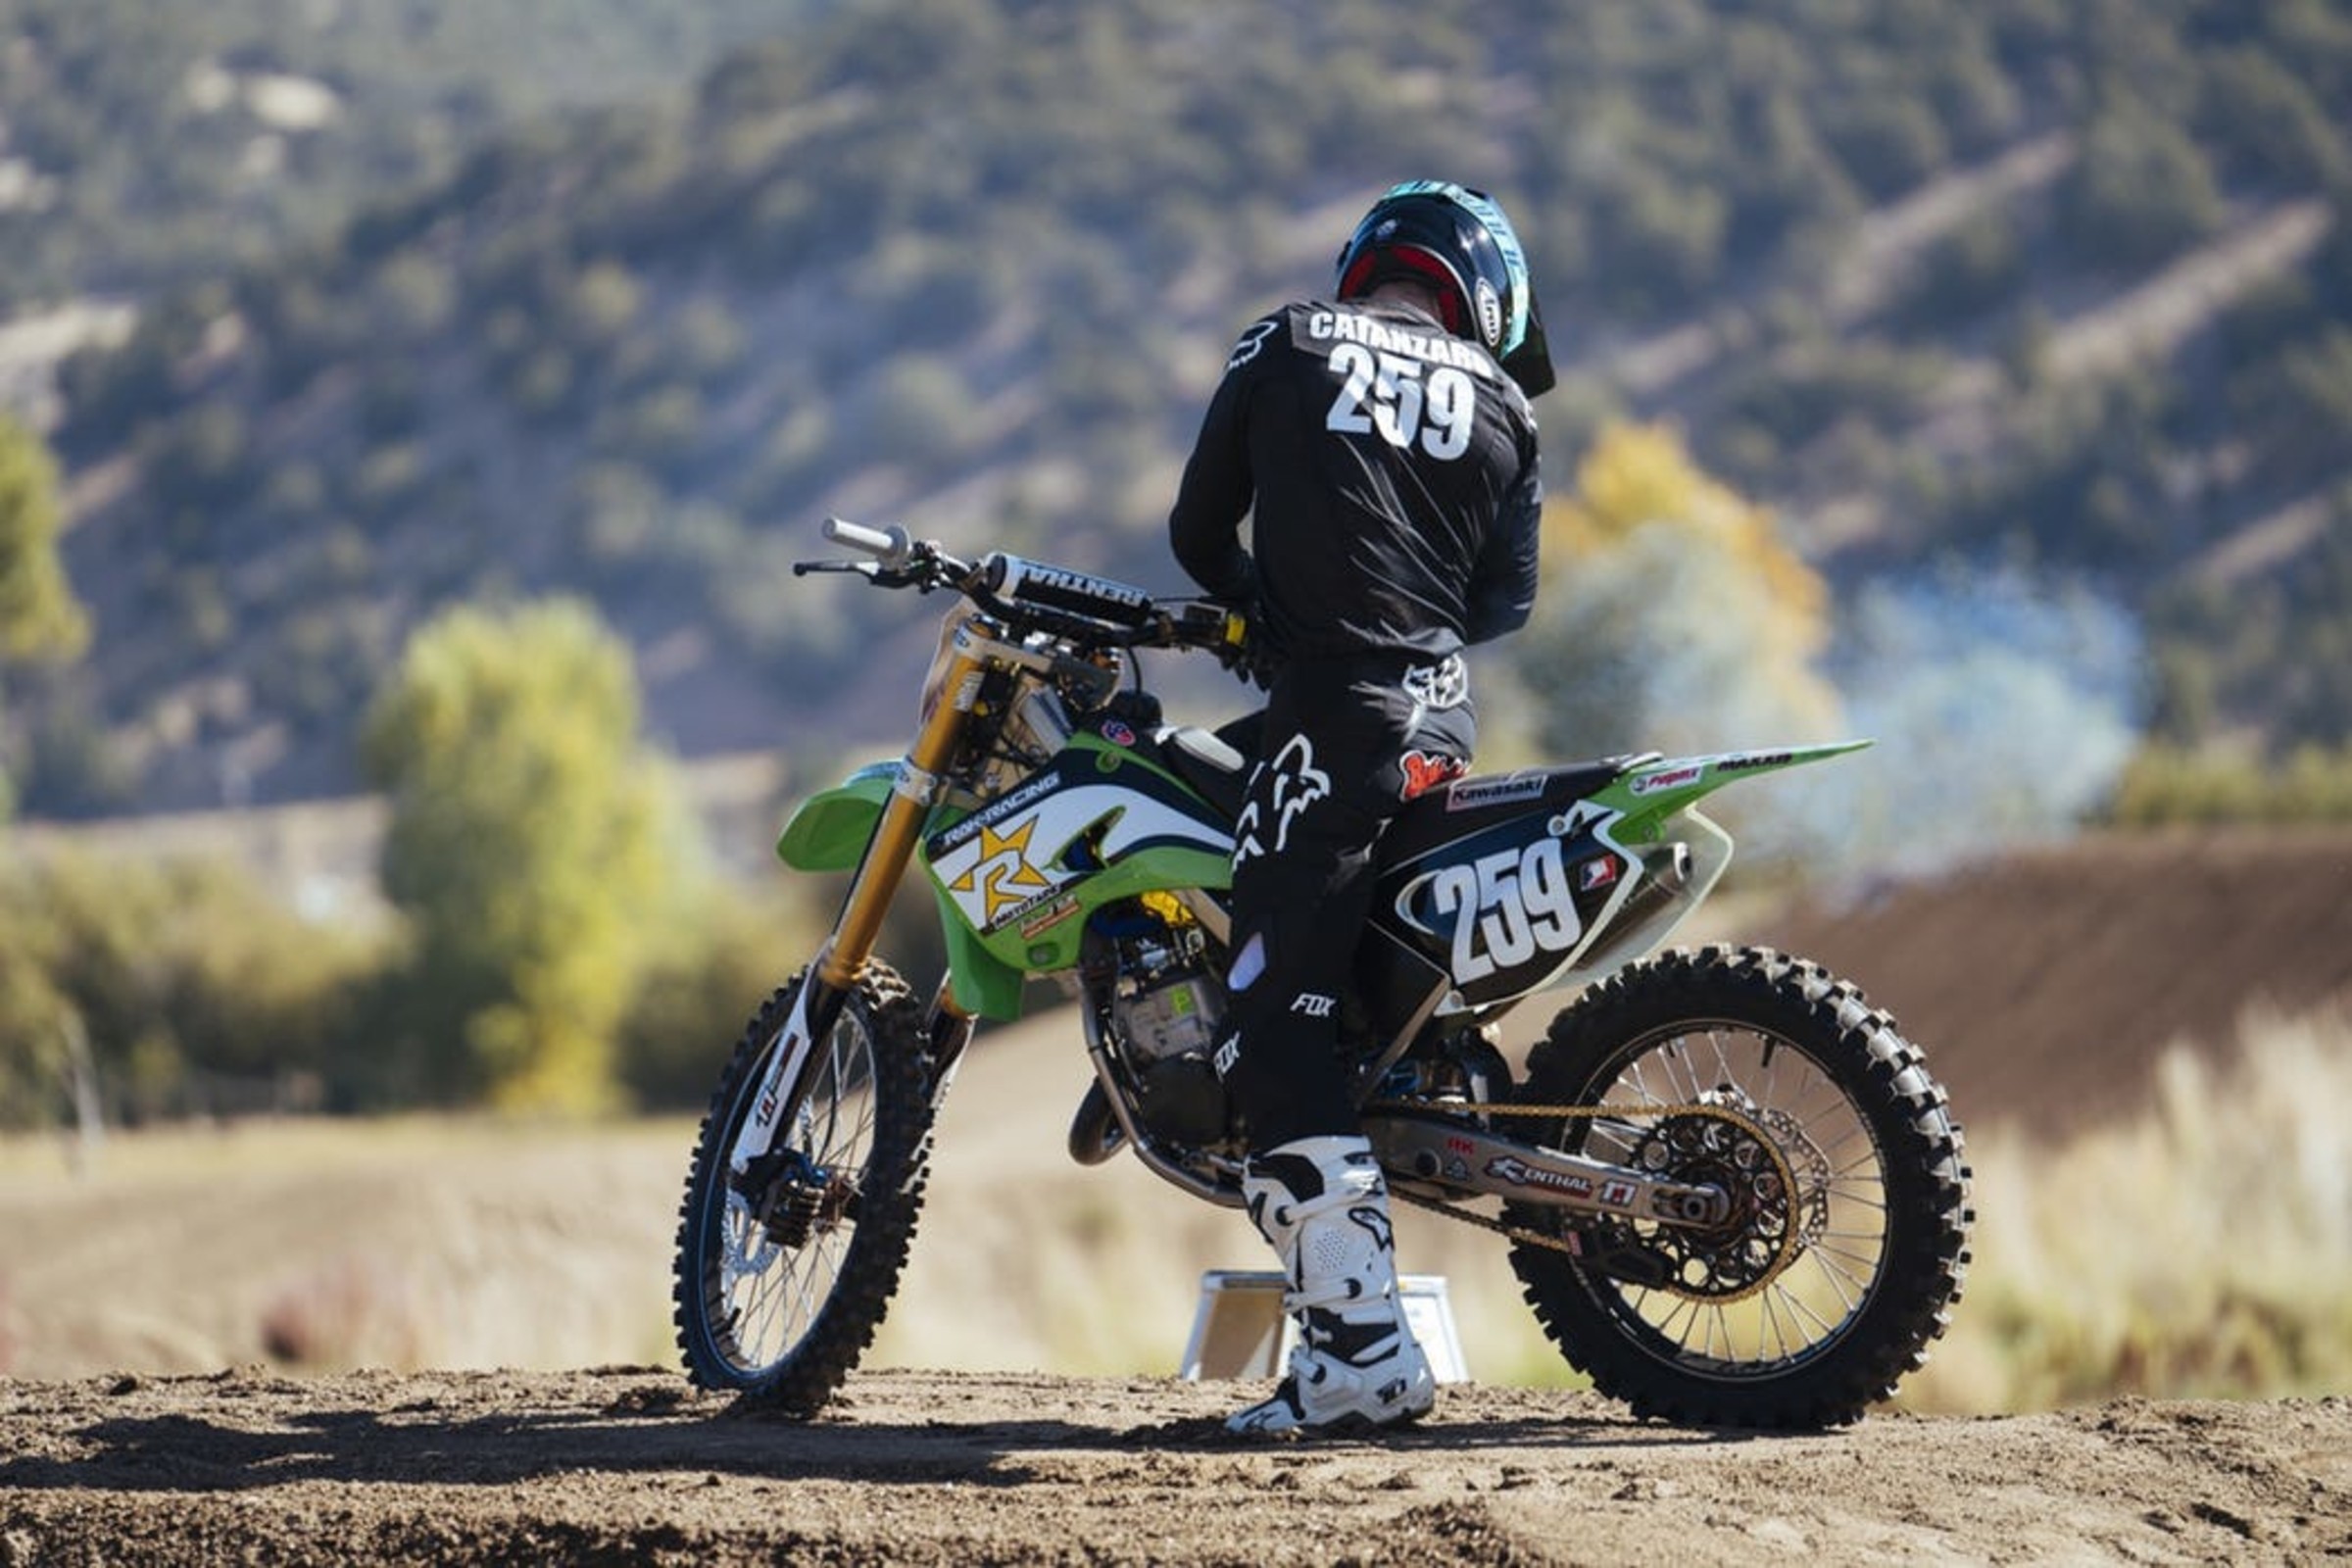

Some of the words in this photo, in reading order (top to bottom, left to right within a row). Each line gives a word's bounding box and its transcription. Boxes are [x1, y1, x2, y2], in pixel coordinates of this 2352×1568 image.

[1326, 342, 1475, 461] 259
[1451, 776, 1543, 802] Kawasaki
[1433, 838, 1583, 986] 259
[1290, 992, 1336, 1016] FOX
[1213, 1031, 1240, 1083] FOX
